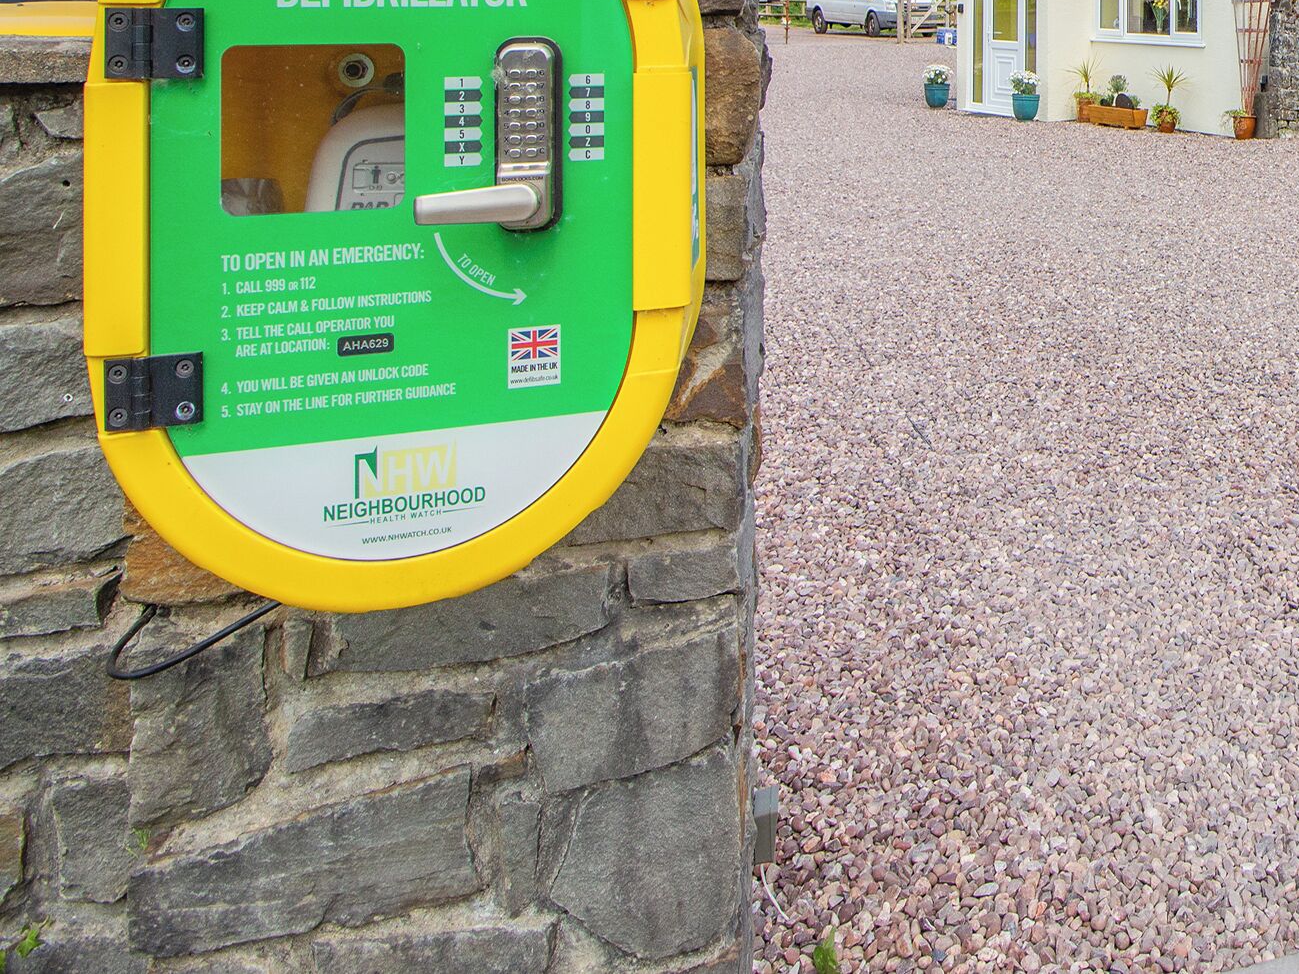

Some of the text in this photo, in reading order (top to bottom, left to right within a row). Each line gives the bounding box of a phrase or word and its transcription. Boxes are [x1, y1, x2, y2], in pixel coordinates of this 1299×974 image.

[459, 79, 463, 87] 1
[586, 75, 590, 84] 6
[459, 92, 464, 100] 2
[586, 88, 590, 97] 7
[459, 104, 464, 113] 3
[586, 101, 590, 109] 8
[459, 117, 465, 126] 4
[585, 113, 590, 121] 9
[586, 125, 590, 134] 0
[460, 130, 464, 139] 5
[585, 138, 590, 146] Z
[459, 143, 465, 152] X
[586, 150, 590, 158] C
[459, 156, 465, 164] Y
[221, 243, 425, 272] TO OPEN IN AN EMERGENCY:
[456, 253, 496, 287] TO OPEN
[222, 277, 316, 295] 1. CALL 999 OR 112
[221, 290, 432, 318] 2. KEEP CALM & FOLLOW INSTRUCTIONS
[221, 316, 395, 341] 3. TELL THE CALL OPERATOR YOU
[236, 337, 389, 357] ARE AT LOCATION: AHA629
[511, 365, 528, 373] MADE
[221, 363, 429, 395] 4. YOU WILL BE GIVEN AN UNLOCK CODE
[221, 382, 456, 417] 5. STAY ON THE LINE FOR FURTHER GUIDANCE
[354, 436, 457, 500] NHW
[323, 486, 486, 523] NEIGHBOURHOOD
[370, 509, 443, 525] HEALTH WATCH
[362, 526, 452, 545] WWW.NHWATCH.CO.UK
